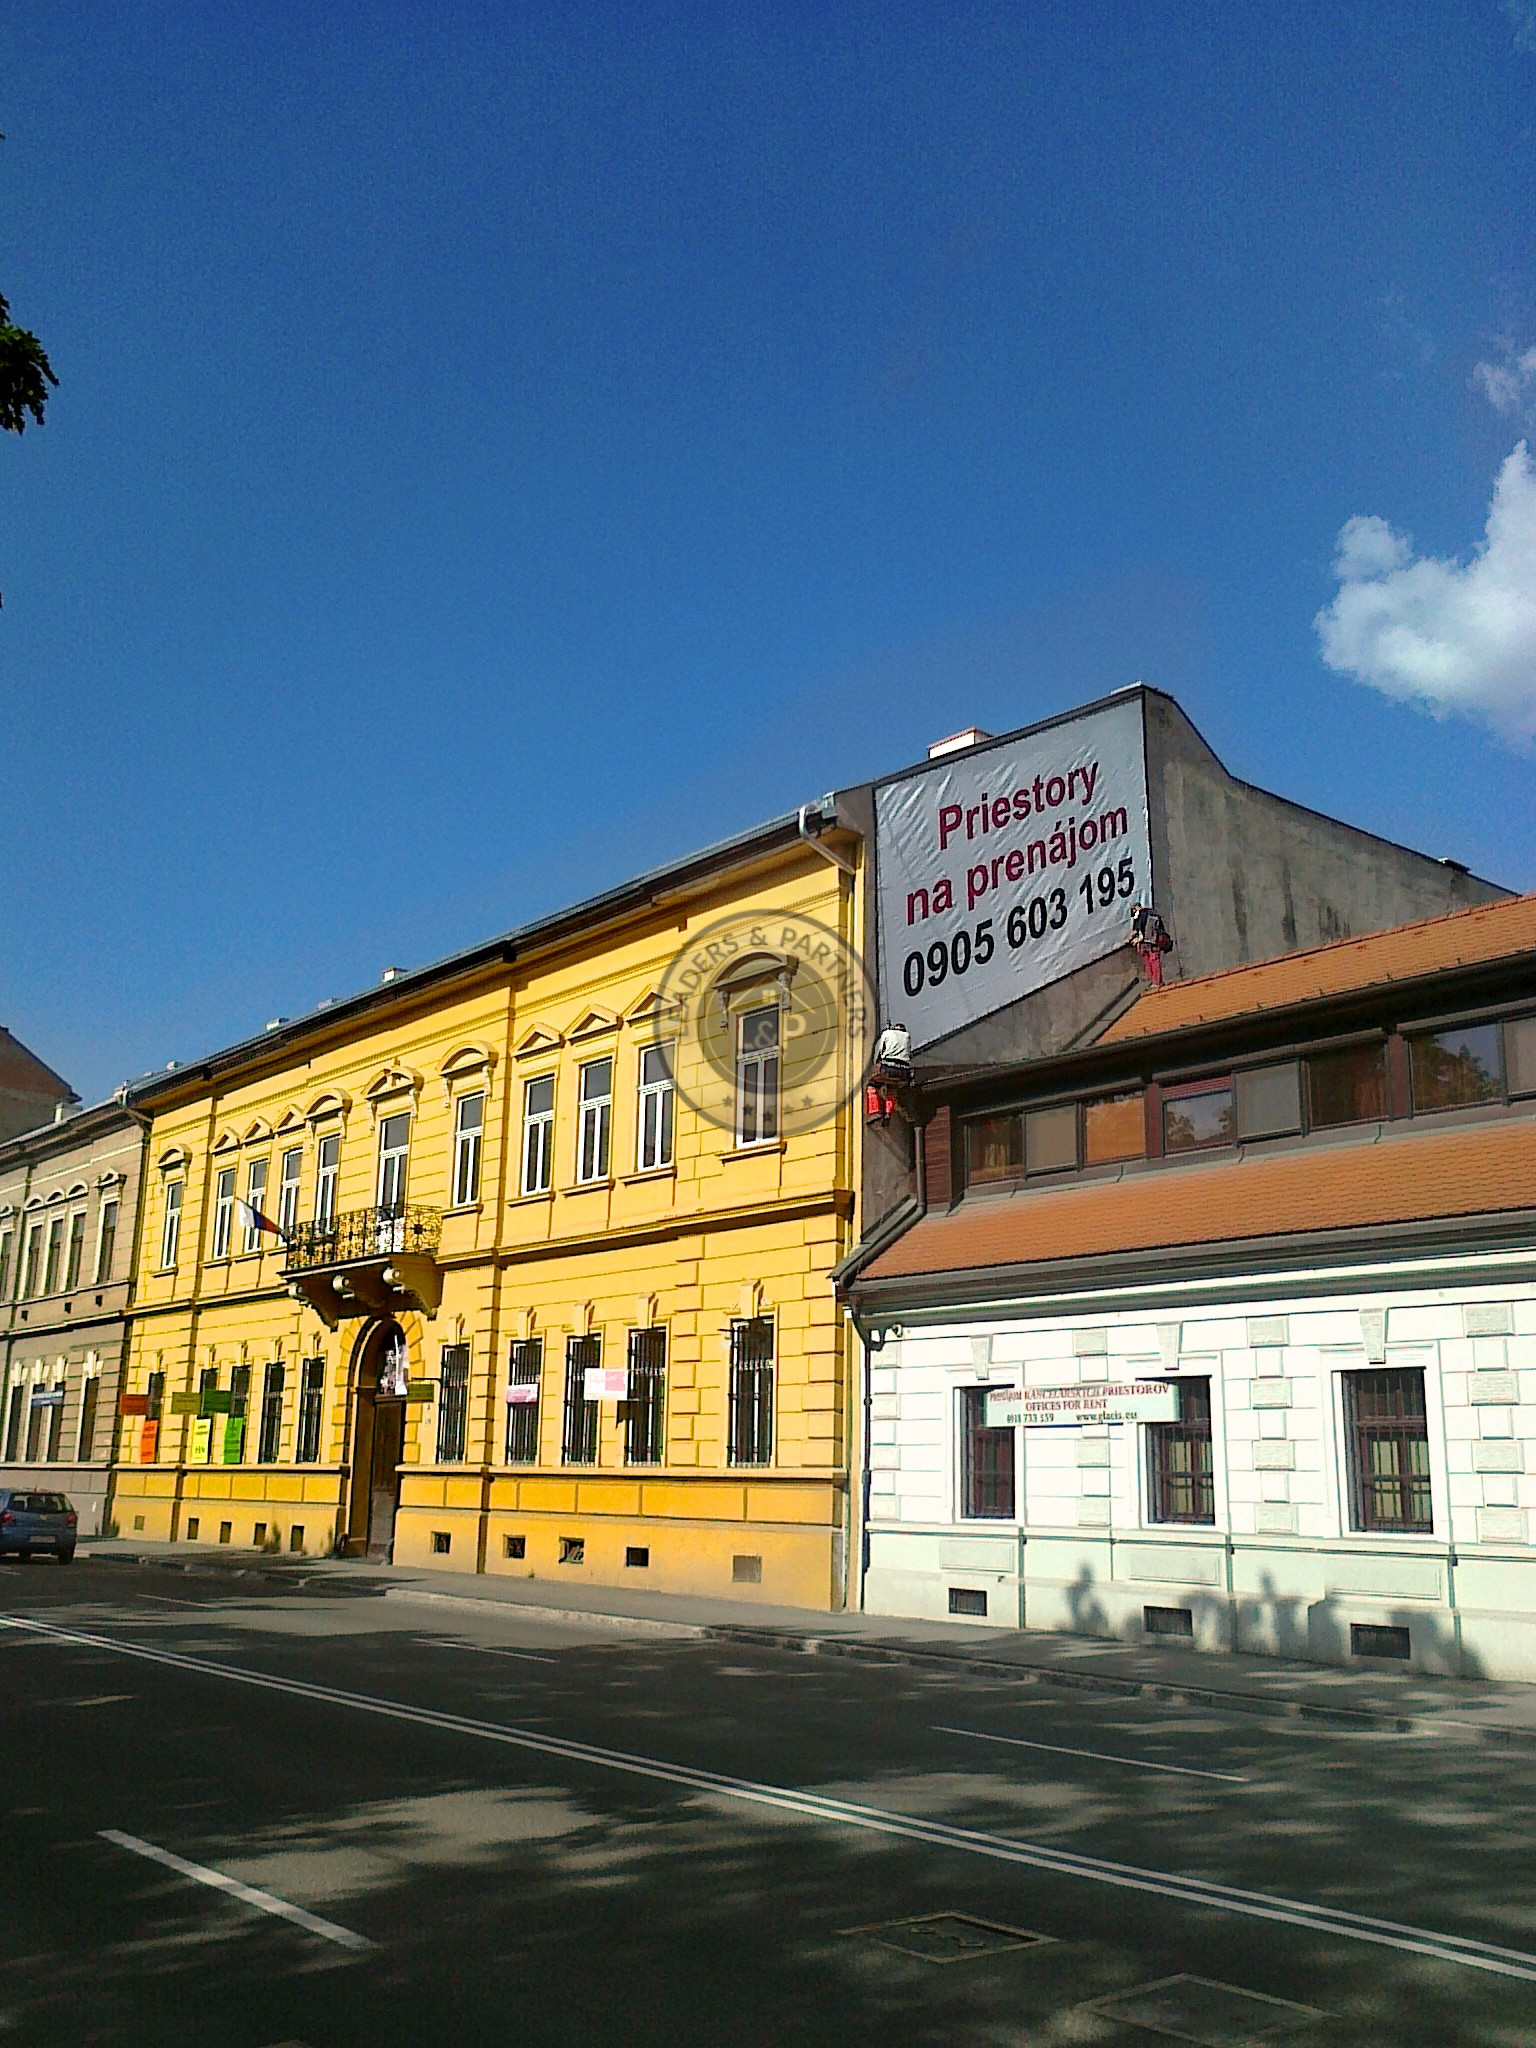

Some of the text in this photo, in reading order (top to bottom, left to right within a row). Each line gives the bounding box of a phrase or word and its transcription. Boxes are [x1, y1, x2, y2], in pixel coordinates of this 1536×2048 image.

[938, 761, 1099, 850] Priestory
[906, 806, 1128, 926] na prenájom
[903, 856, 1135, 997] 0905 603 195
[1025, 1399, 1108, 1412] OFFICES FOR RENT
